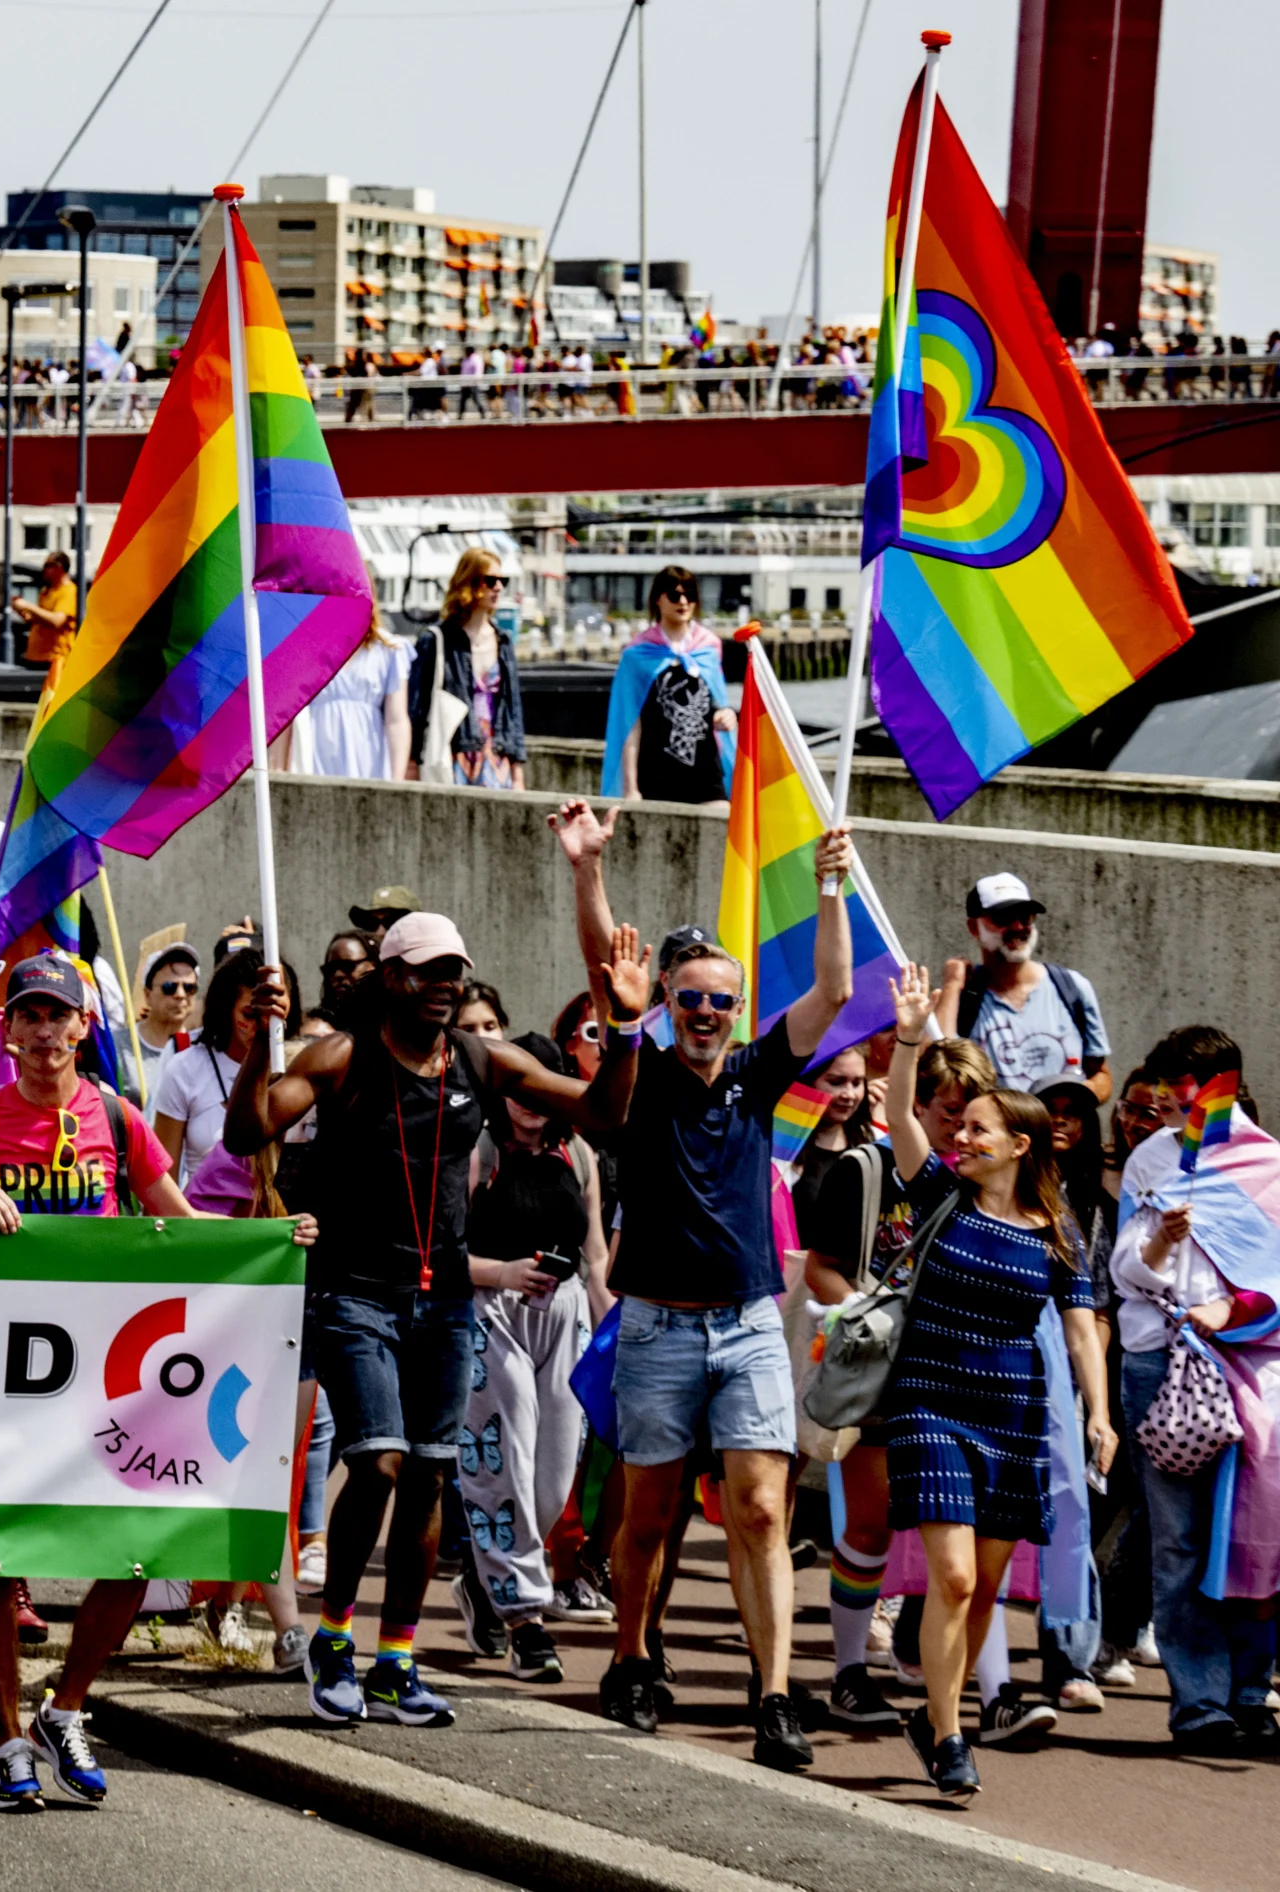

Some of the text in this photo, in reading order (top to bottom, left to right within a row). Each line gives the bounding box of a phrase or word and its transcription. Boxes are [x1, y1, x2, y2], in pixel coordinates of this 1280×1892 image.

[0, 1159, 101, 1214] PRIDE
[94, 1418, 203, 1485] 75 JAAR
